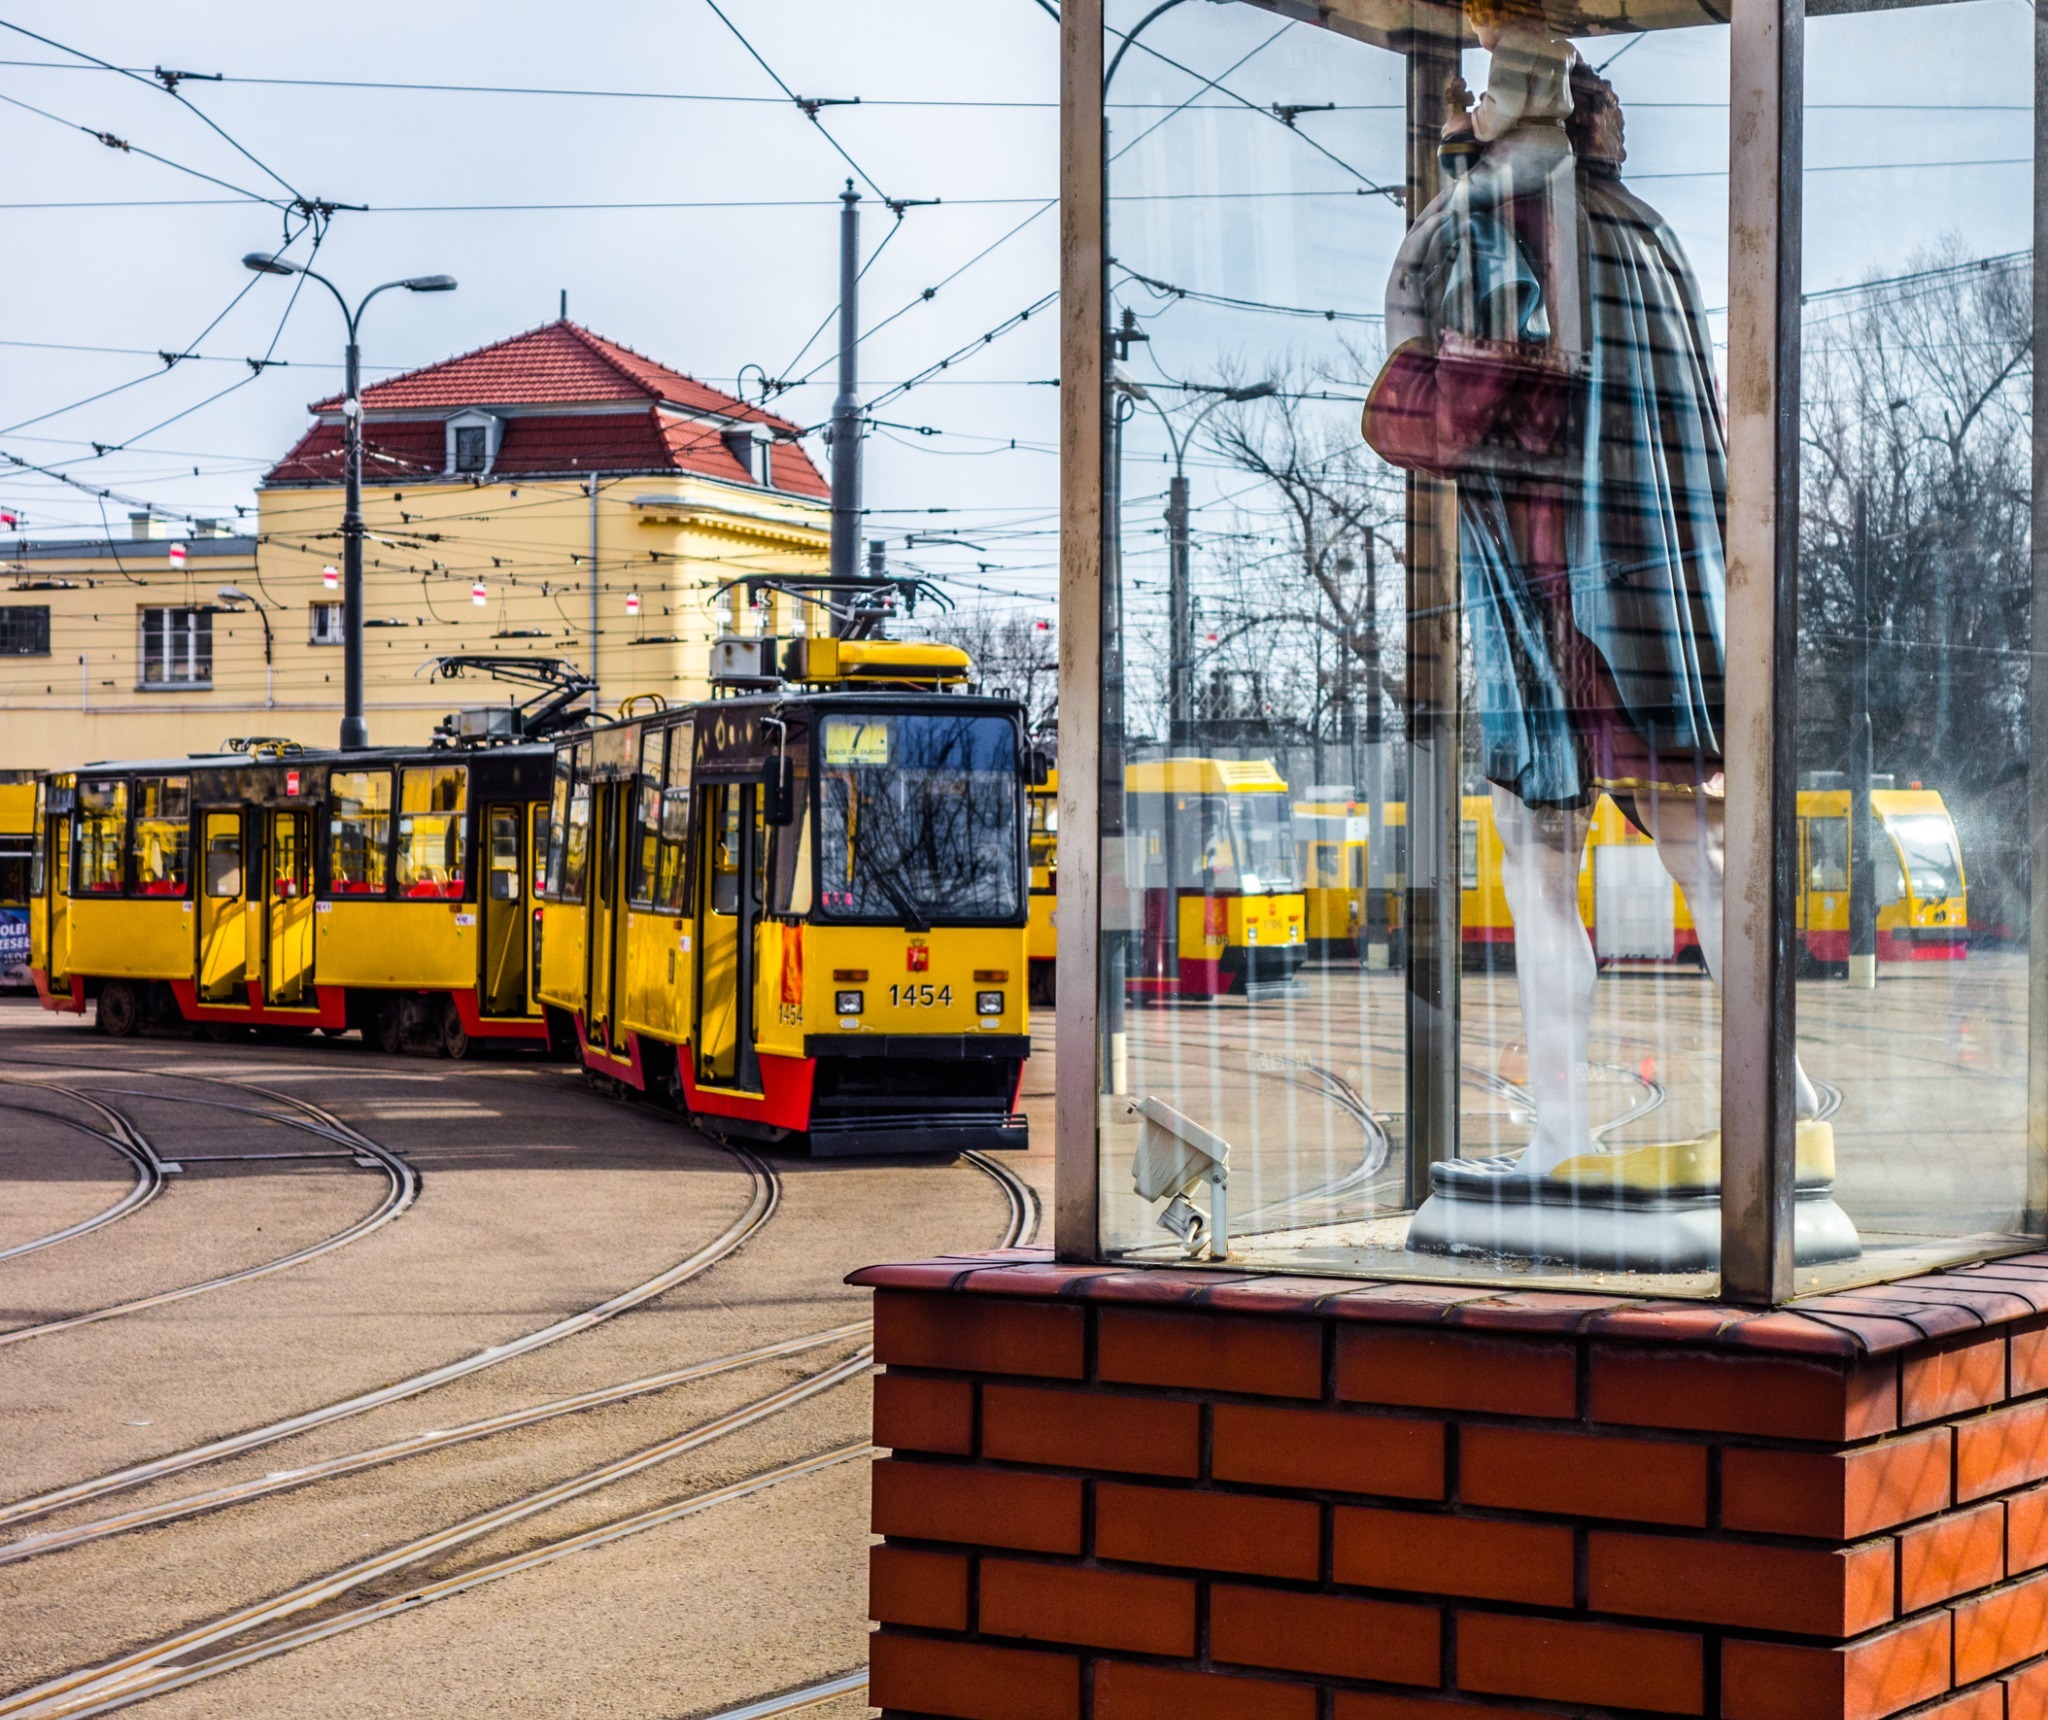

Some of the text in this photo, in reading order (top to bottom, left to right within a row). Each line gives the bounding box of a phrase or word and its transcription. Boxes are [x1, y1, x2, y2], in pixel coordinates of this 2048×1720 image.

[850, 722, 866, 749] 7
[889, 984, 953, 1007] 1454
[778, 1003, 804, 1026] 1454
